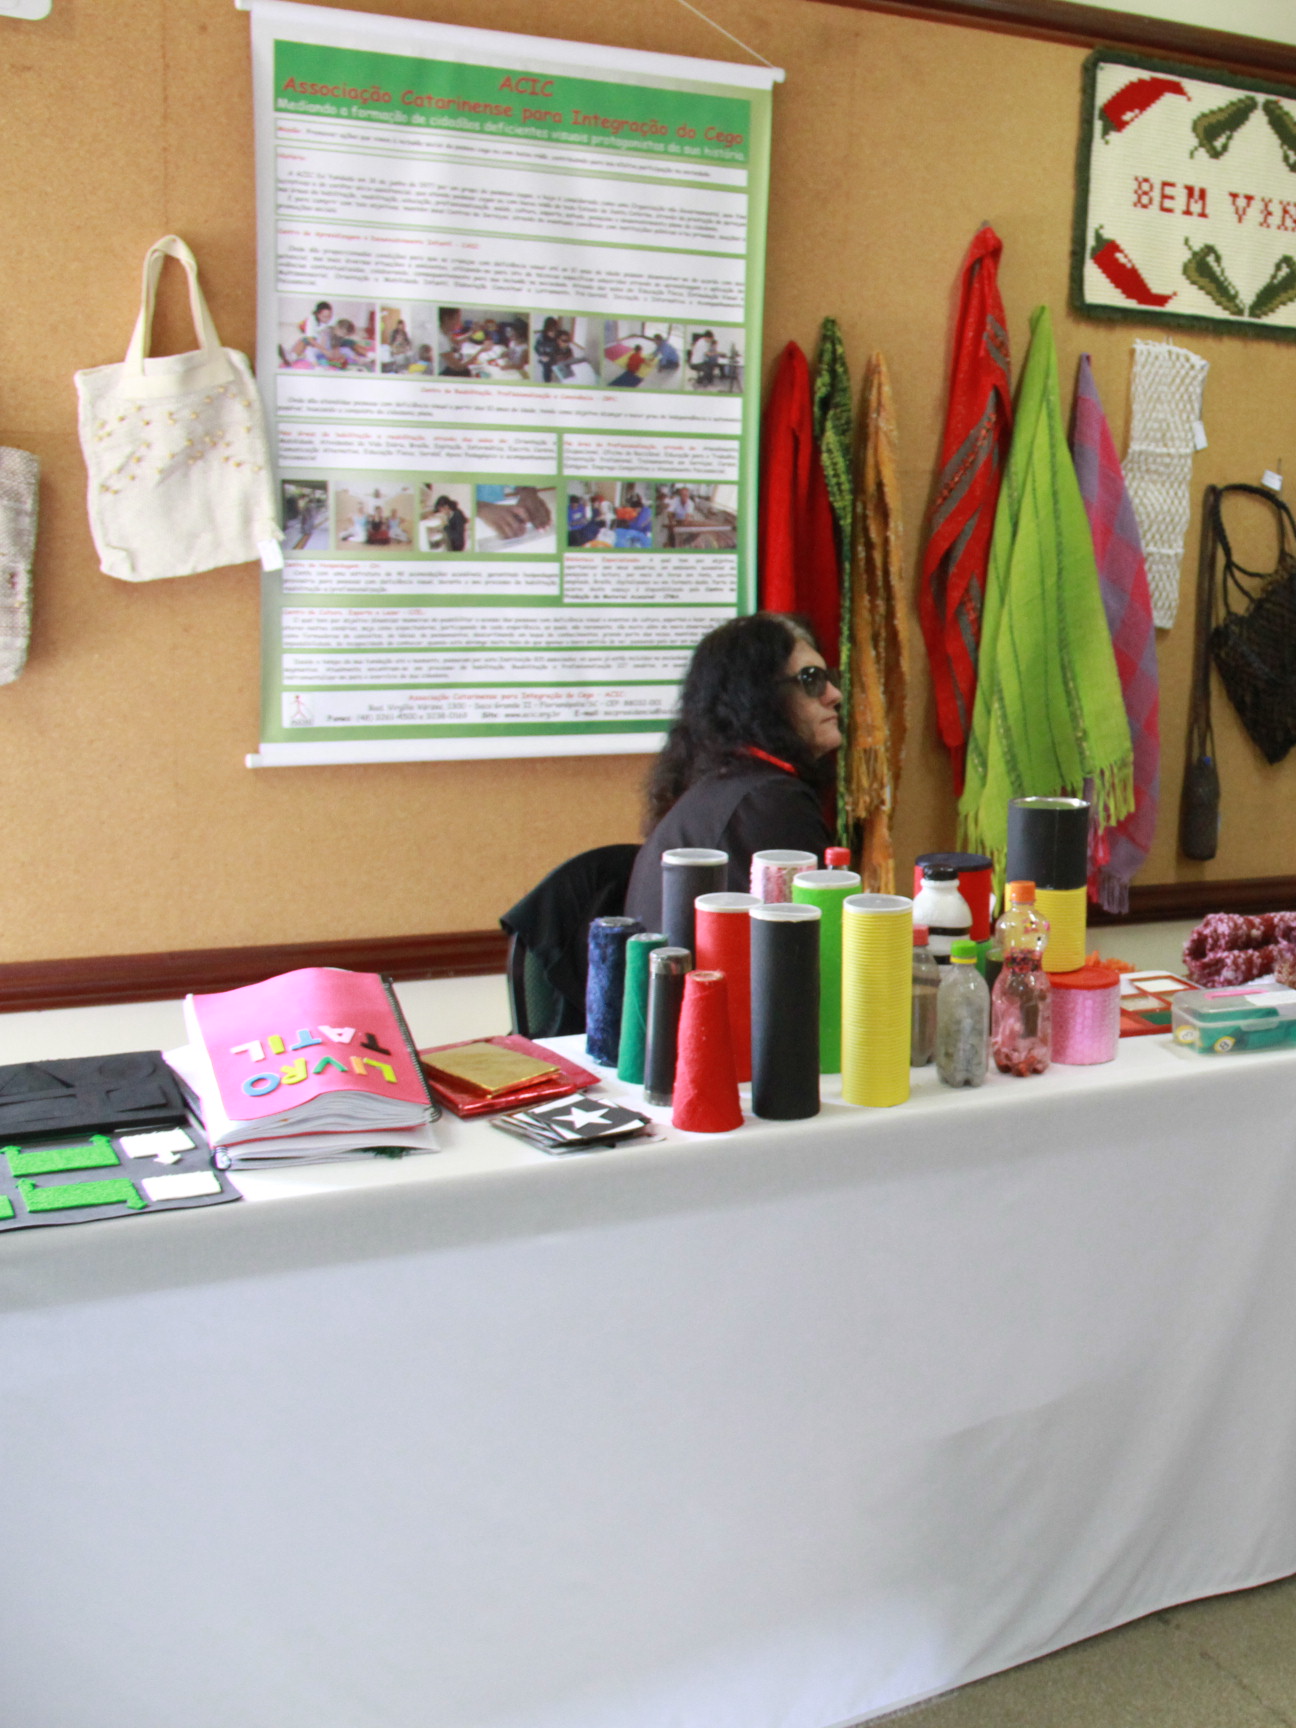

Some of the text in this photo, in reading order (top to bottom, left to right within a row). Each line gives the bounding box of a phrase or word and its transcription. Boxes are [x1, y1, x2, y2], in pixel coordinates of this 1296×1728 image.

[499, 75, 555, 98] ACIC
[276, 97, 338, 115] Mediando
[351, 105, 409, 124] formação
[411, 112, 427, 124] de
[483, 120, 549, 139] deficientes
[283, 76, 744, 148] Associação Catarinense para Integração do Cego
[1133, 176, 1209, 219] BEM
[229, 1025, 392, 1062] TATIL
[242, 1057, 398, 1097] LIVRO
